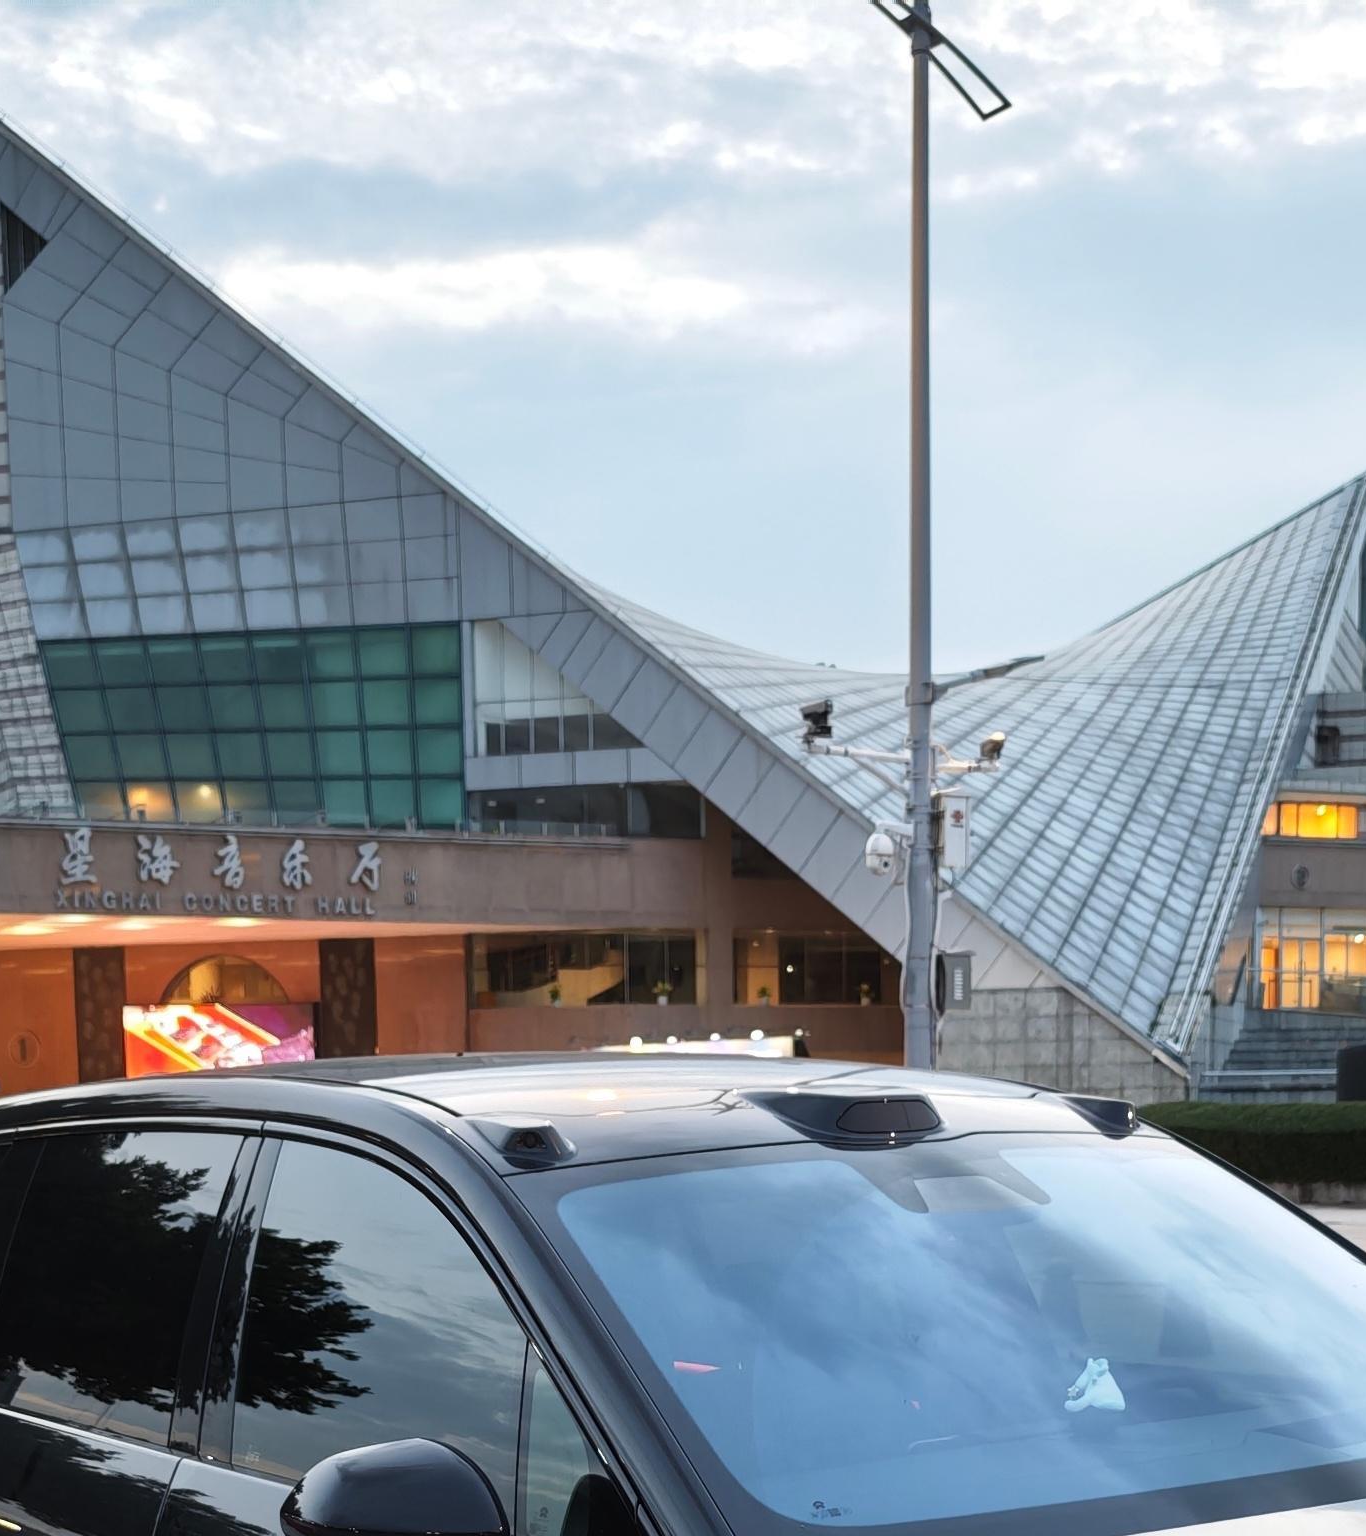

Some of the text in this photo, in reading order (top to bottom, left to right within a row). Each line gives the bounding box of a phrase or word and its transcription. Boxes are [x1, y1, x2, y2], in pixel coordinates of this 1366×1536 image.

[61, 827, 381, 891] 星海音乐厅
[56, 888, 377, 915] XINGHAI CONCERT HALL
